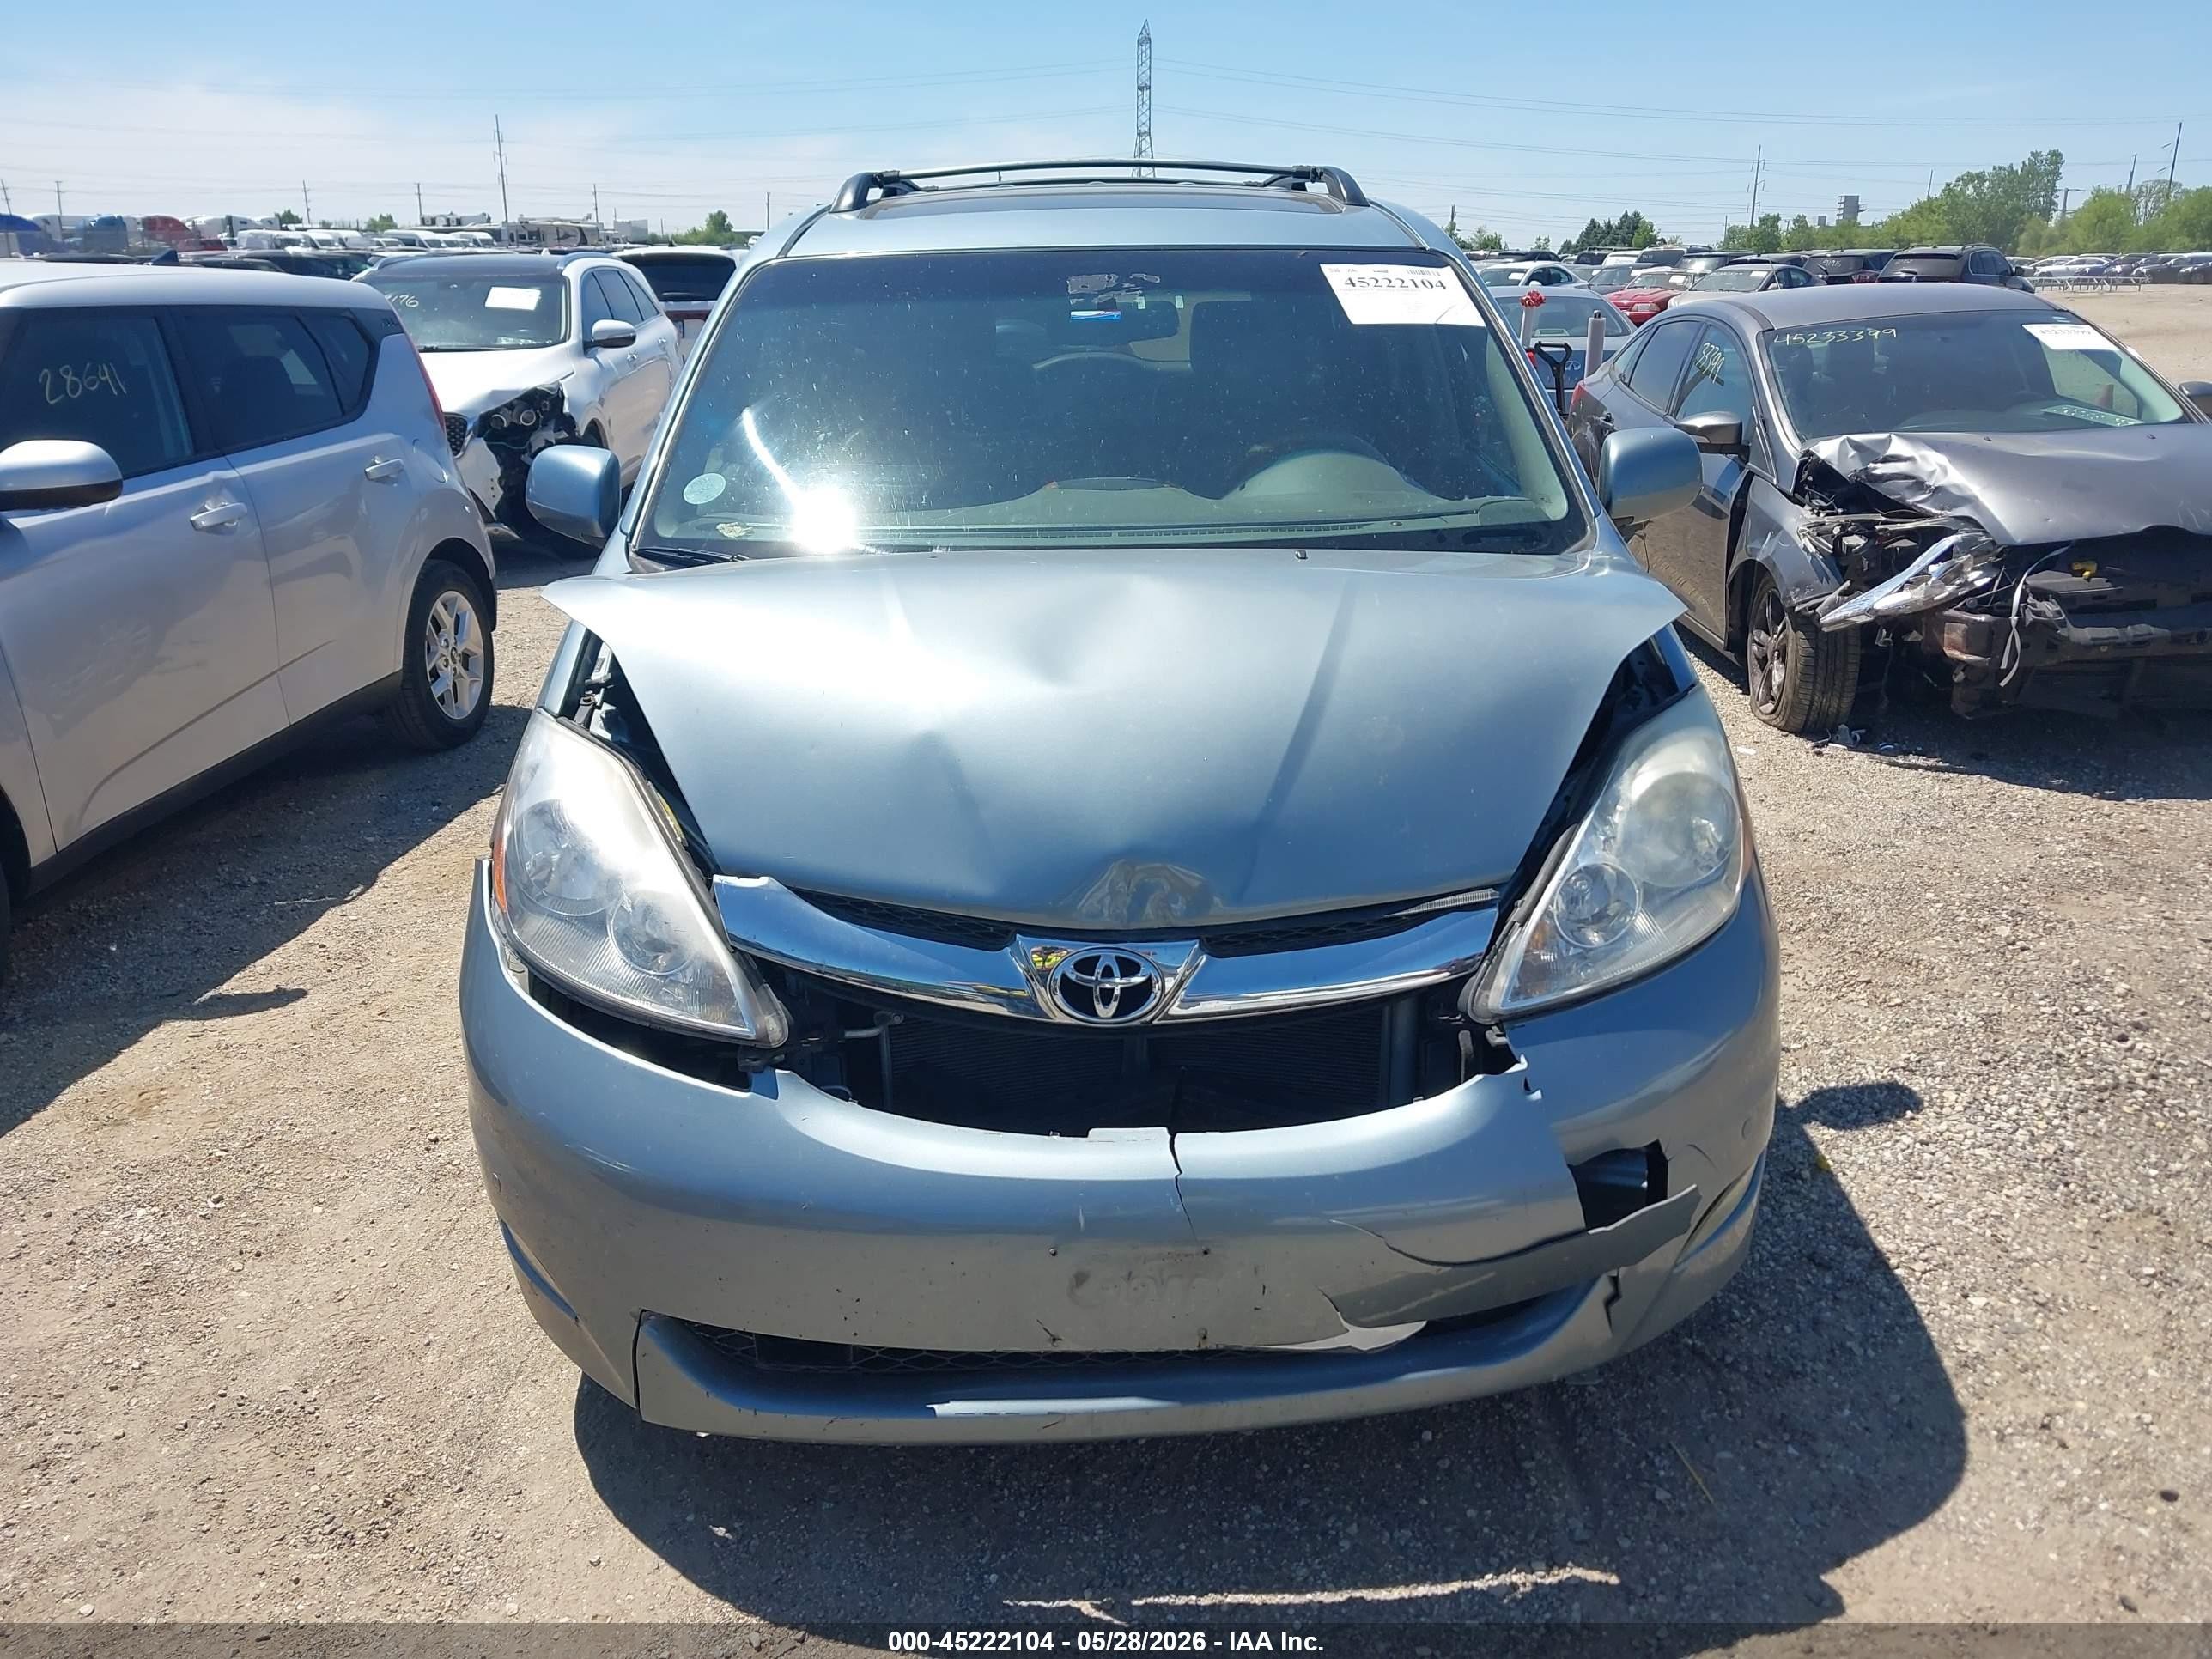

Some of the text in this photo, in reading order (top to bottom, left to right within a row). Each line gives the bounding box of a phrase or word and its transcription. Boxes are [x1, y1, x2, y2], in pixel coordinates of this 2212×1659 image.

[1345, 276, 1447, 289] 45222104
[1774, 328, 1897, 345] 45233399
[39, 362, 127, 404] 28641
